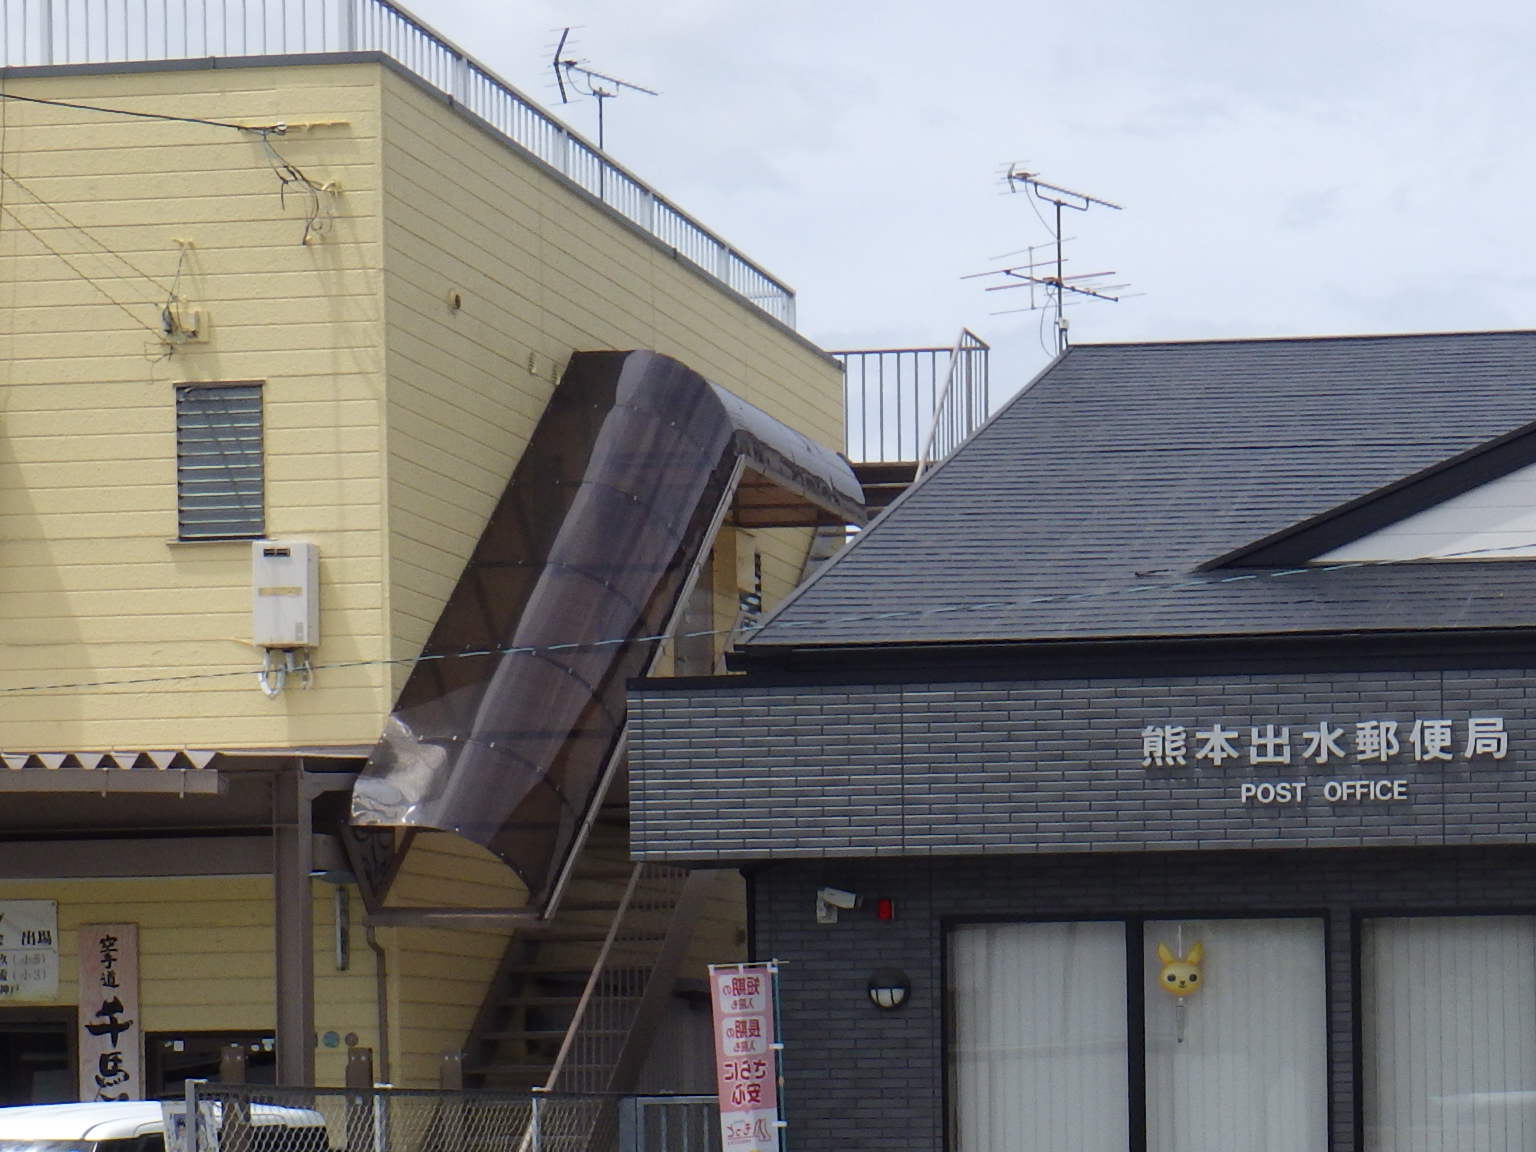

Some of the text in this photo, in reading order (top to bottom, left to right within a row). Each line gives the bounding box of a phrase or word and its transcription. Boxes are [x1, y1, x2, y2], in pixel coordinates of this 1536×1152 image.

[1141, 717, 1509, 768] 熊本出水郵便局
[1241, 780, 1408, 804] POST OFFICE
[99, 933, 120, 989] 空手道
